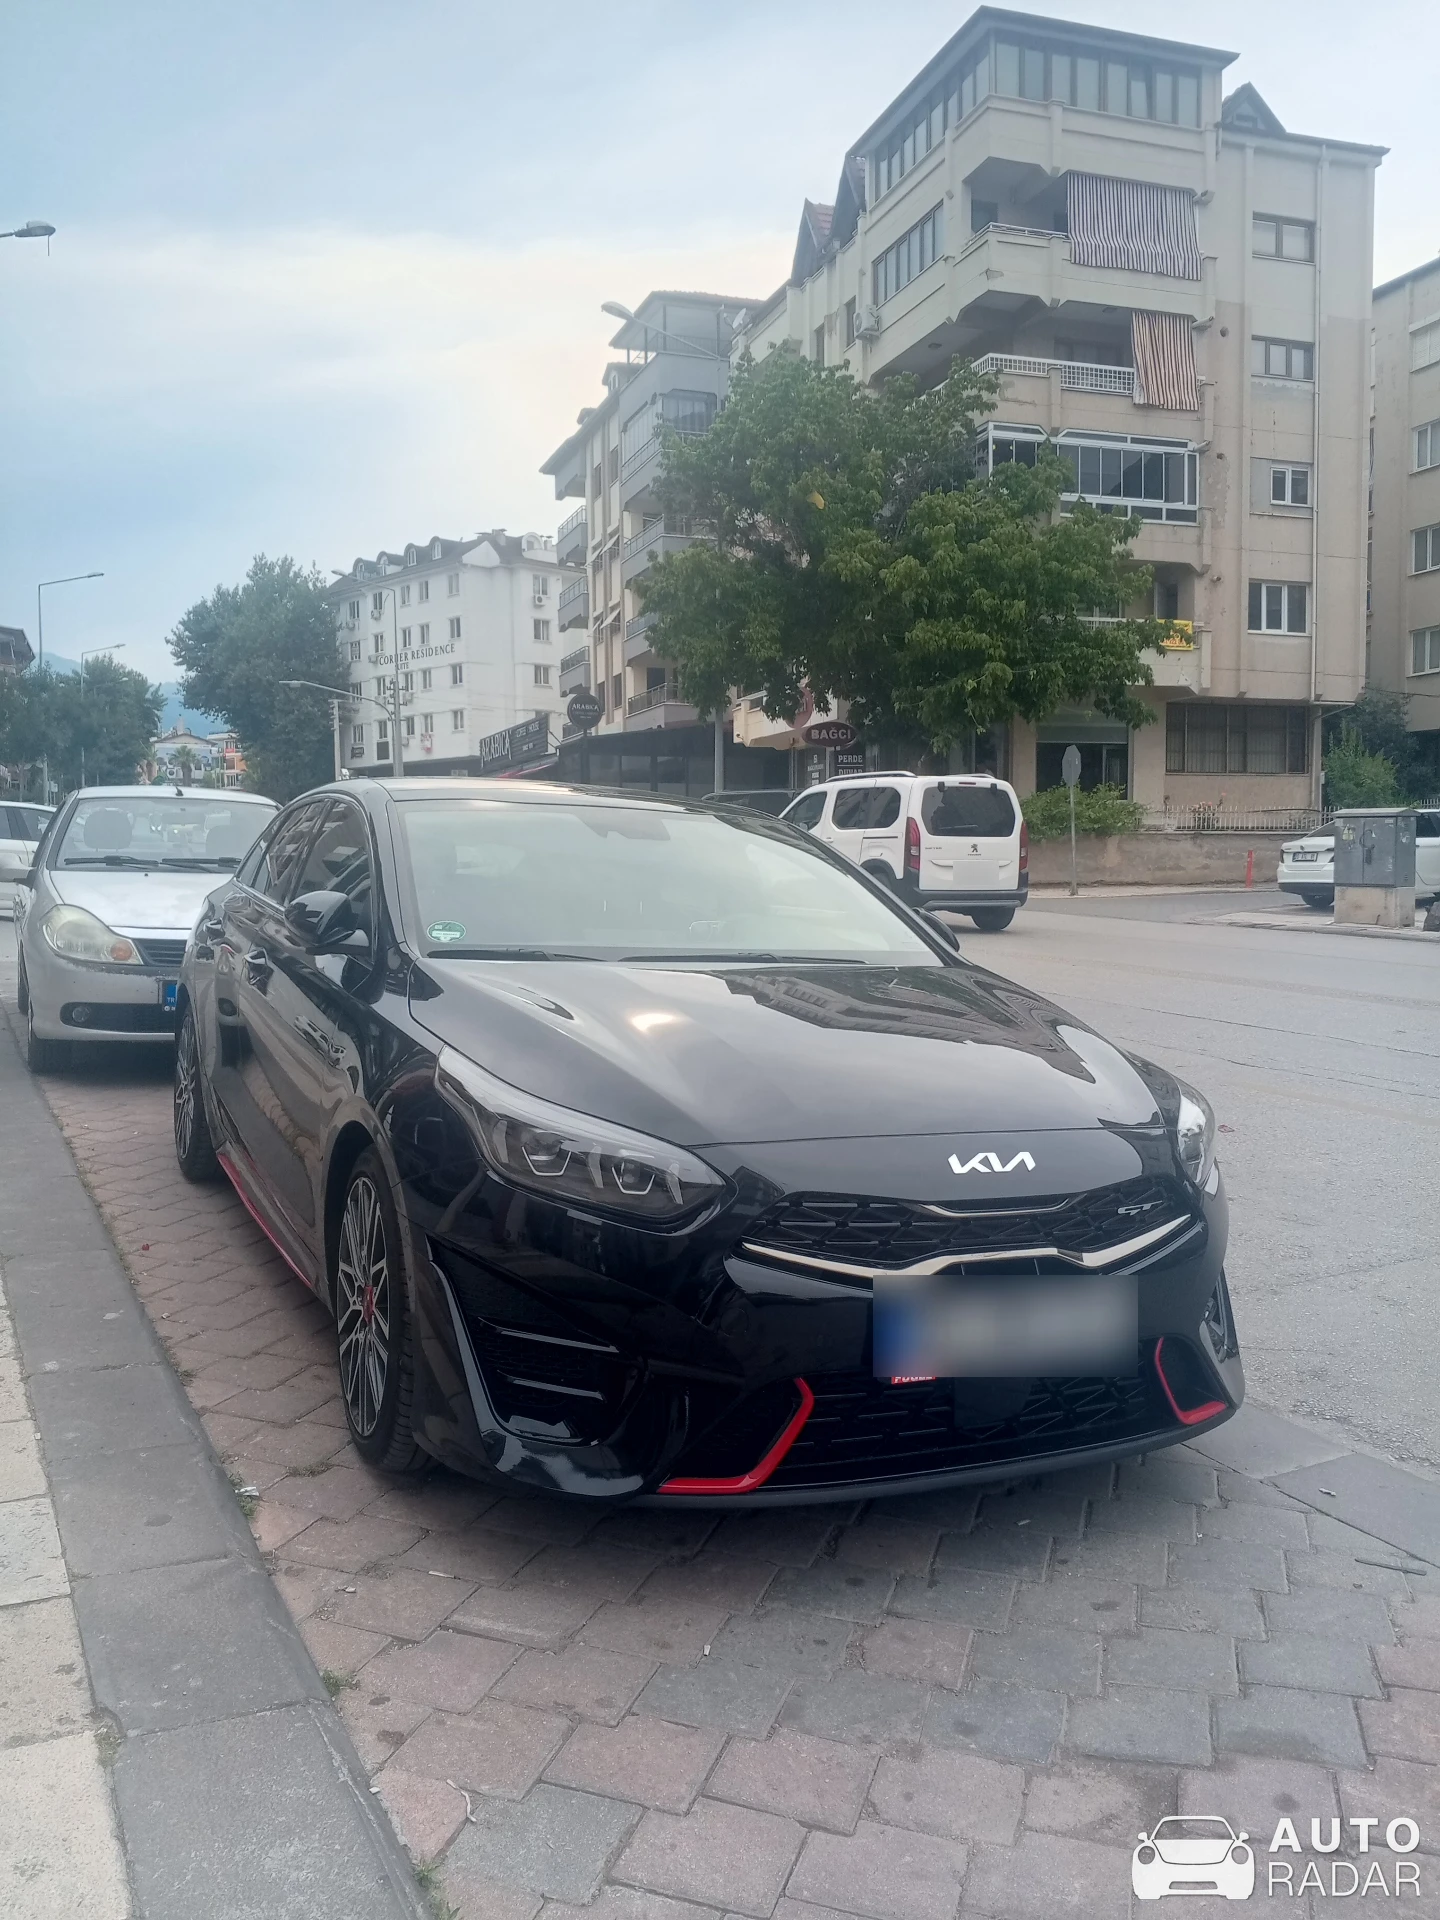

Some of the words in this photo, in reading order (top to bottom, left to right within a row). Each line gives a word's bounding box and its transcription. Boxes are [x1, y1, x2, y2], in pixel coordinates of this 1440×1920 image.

[411, 643, 456, 660] RESIDENCE
[481, 729, 512, 768] ARABICA
[838, 754, 863, 763] PERDE
[948, 1151, 1036, 1174] KIA
[1117, 1200, 1163, 1216] GT
